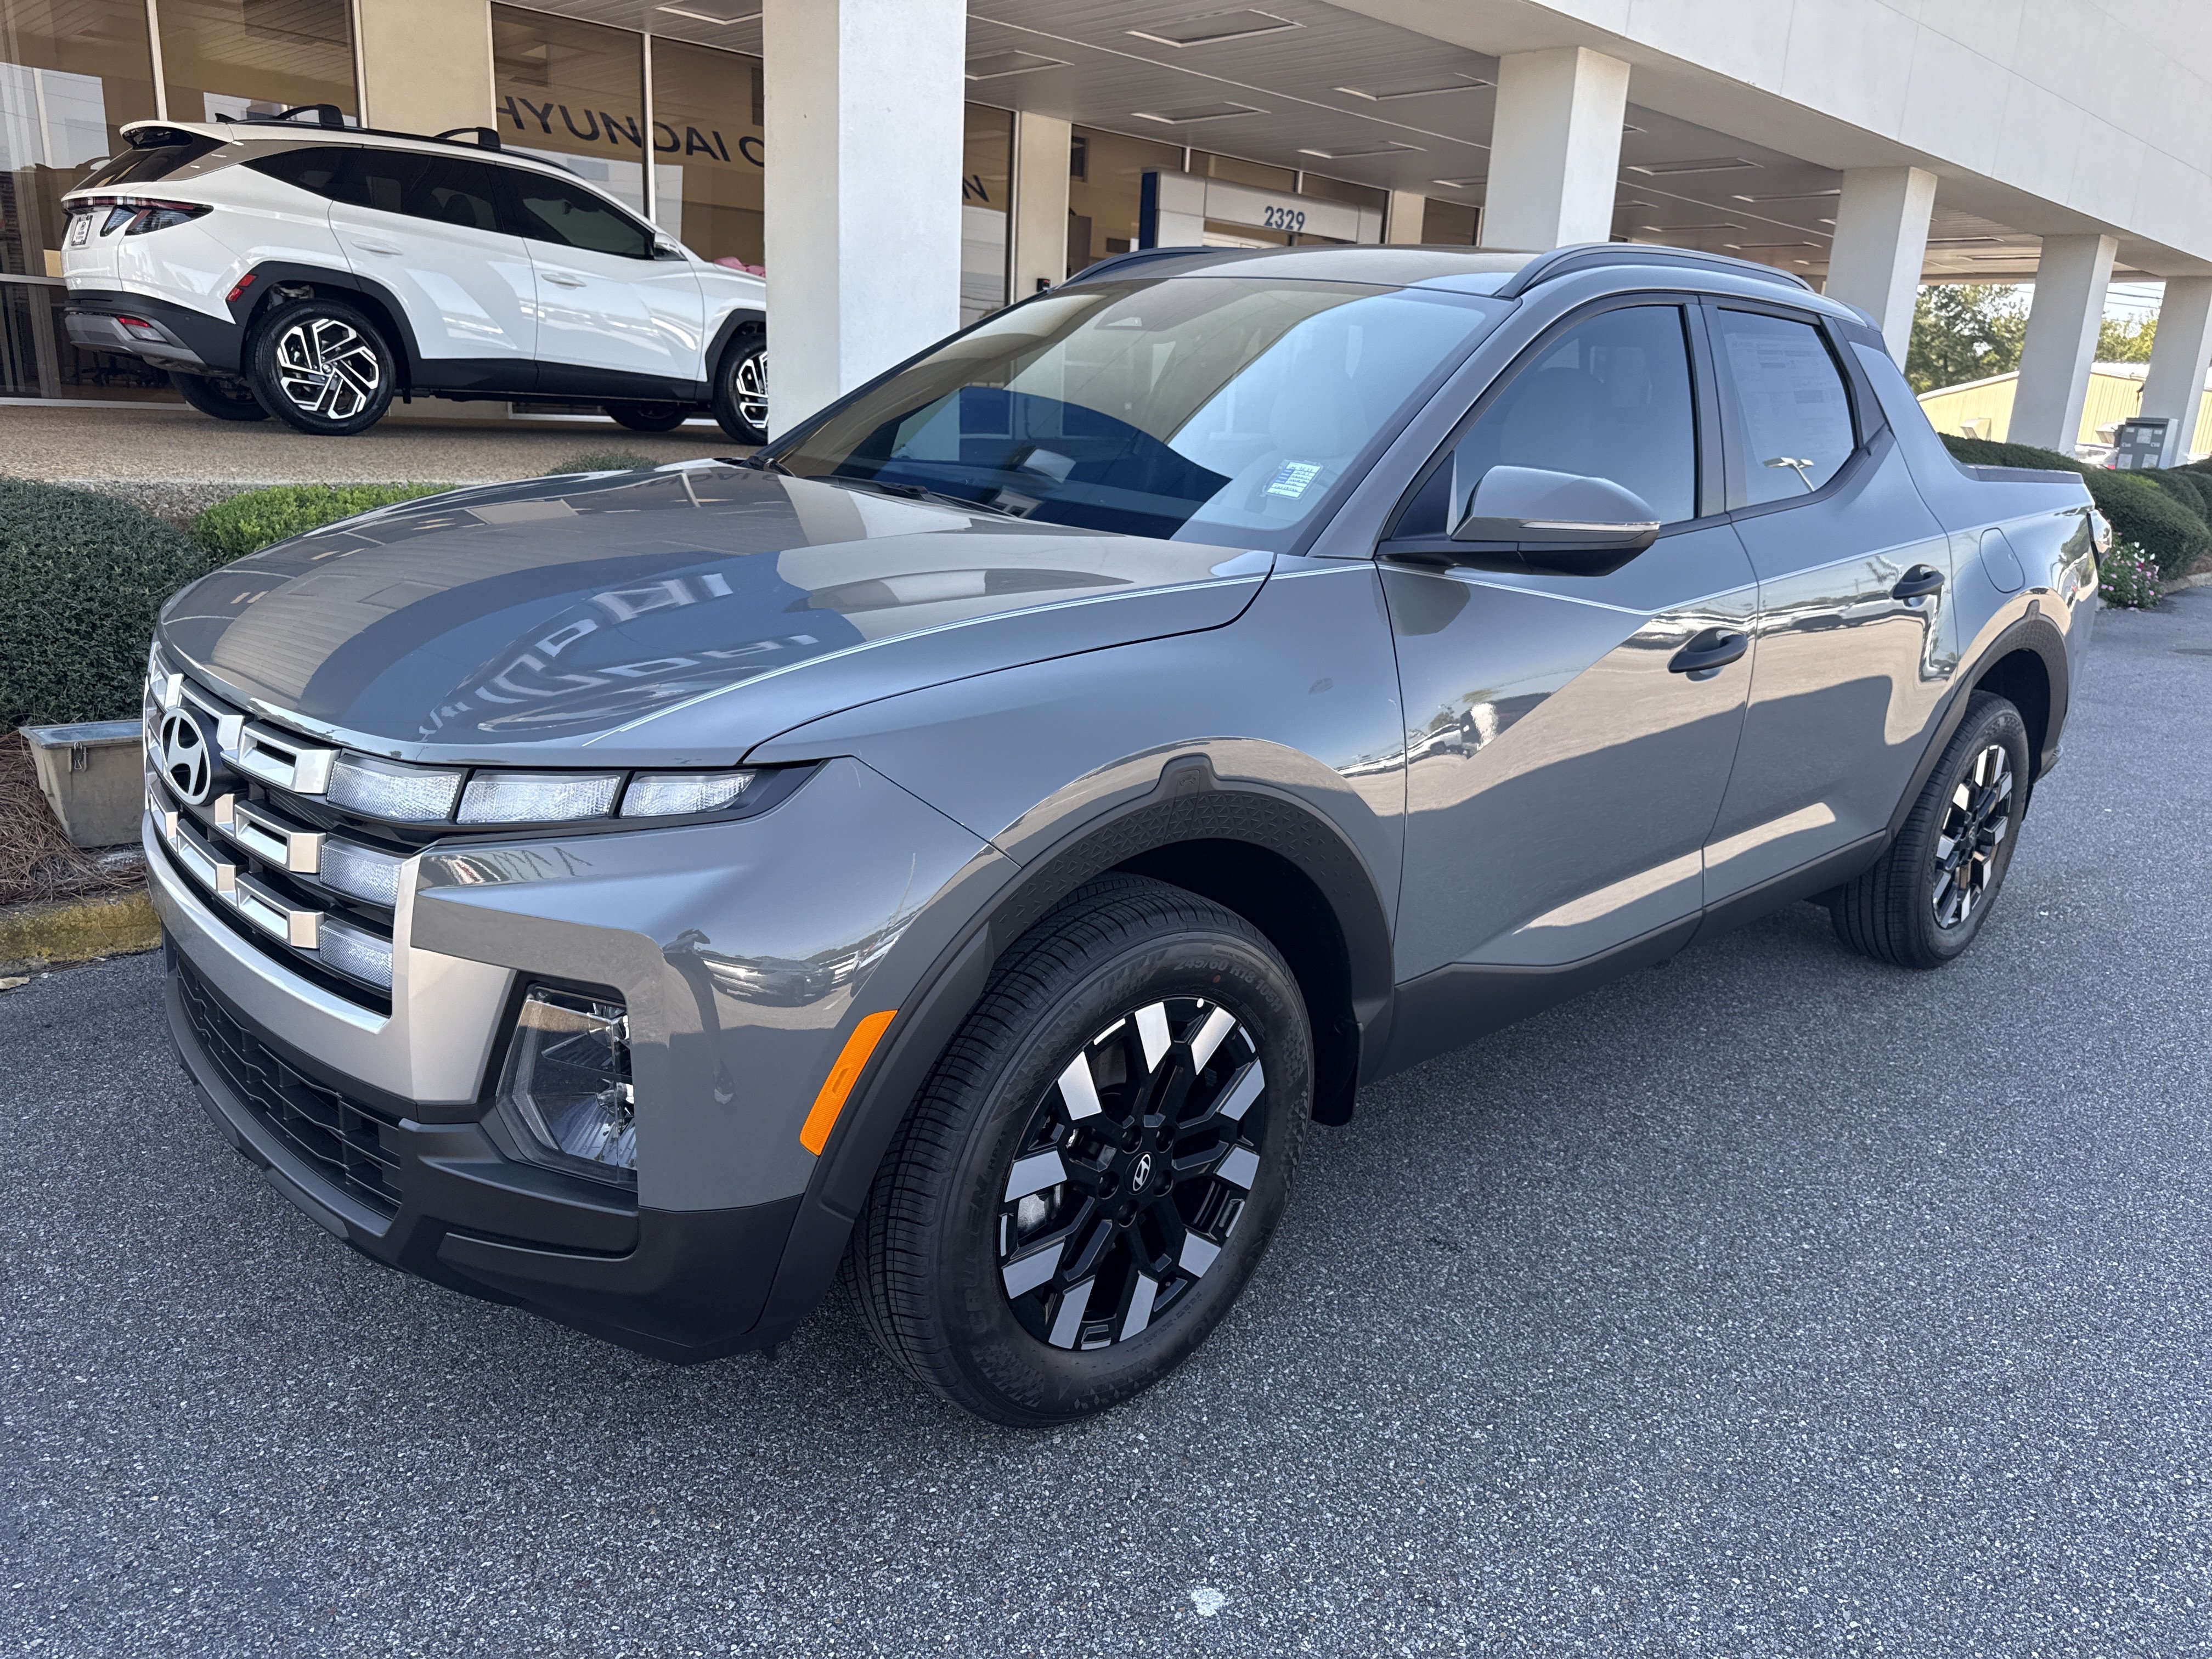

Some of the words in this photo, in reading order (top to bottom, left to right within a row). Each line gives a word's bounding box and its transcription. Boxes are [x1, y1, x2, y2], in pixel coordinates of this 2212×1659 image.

[496, 95, 731, 163] HYUNDAI
[1263, 206, 1305, 232] 2329
[1173, 958, 1229, 972] 245/60
[1229, 963, 1257, 984] R18
[1255, 979, 1284, 1013] 105H
